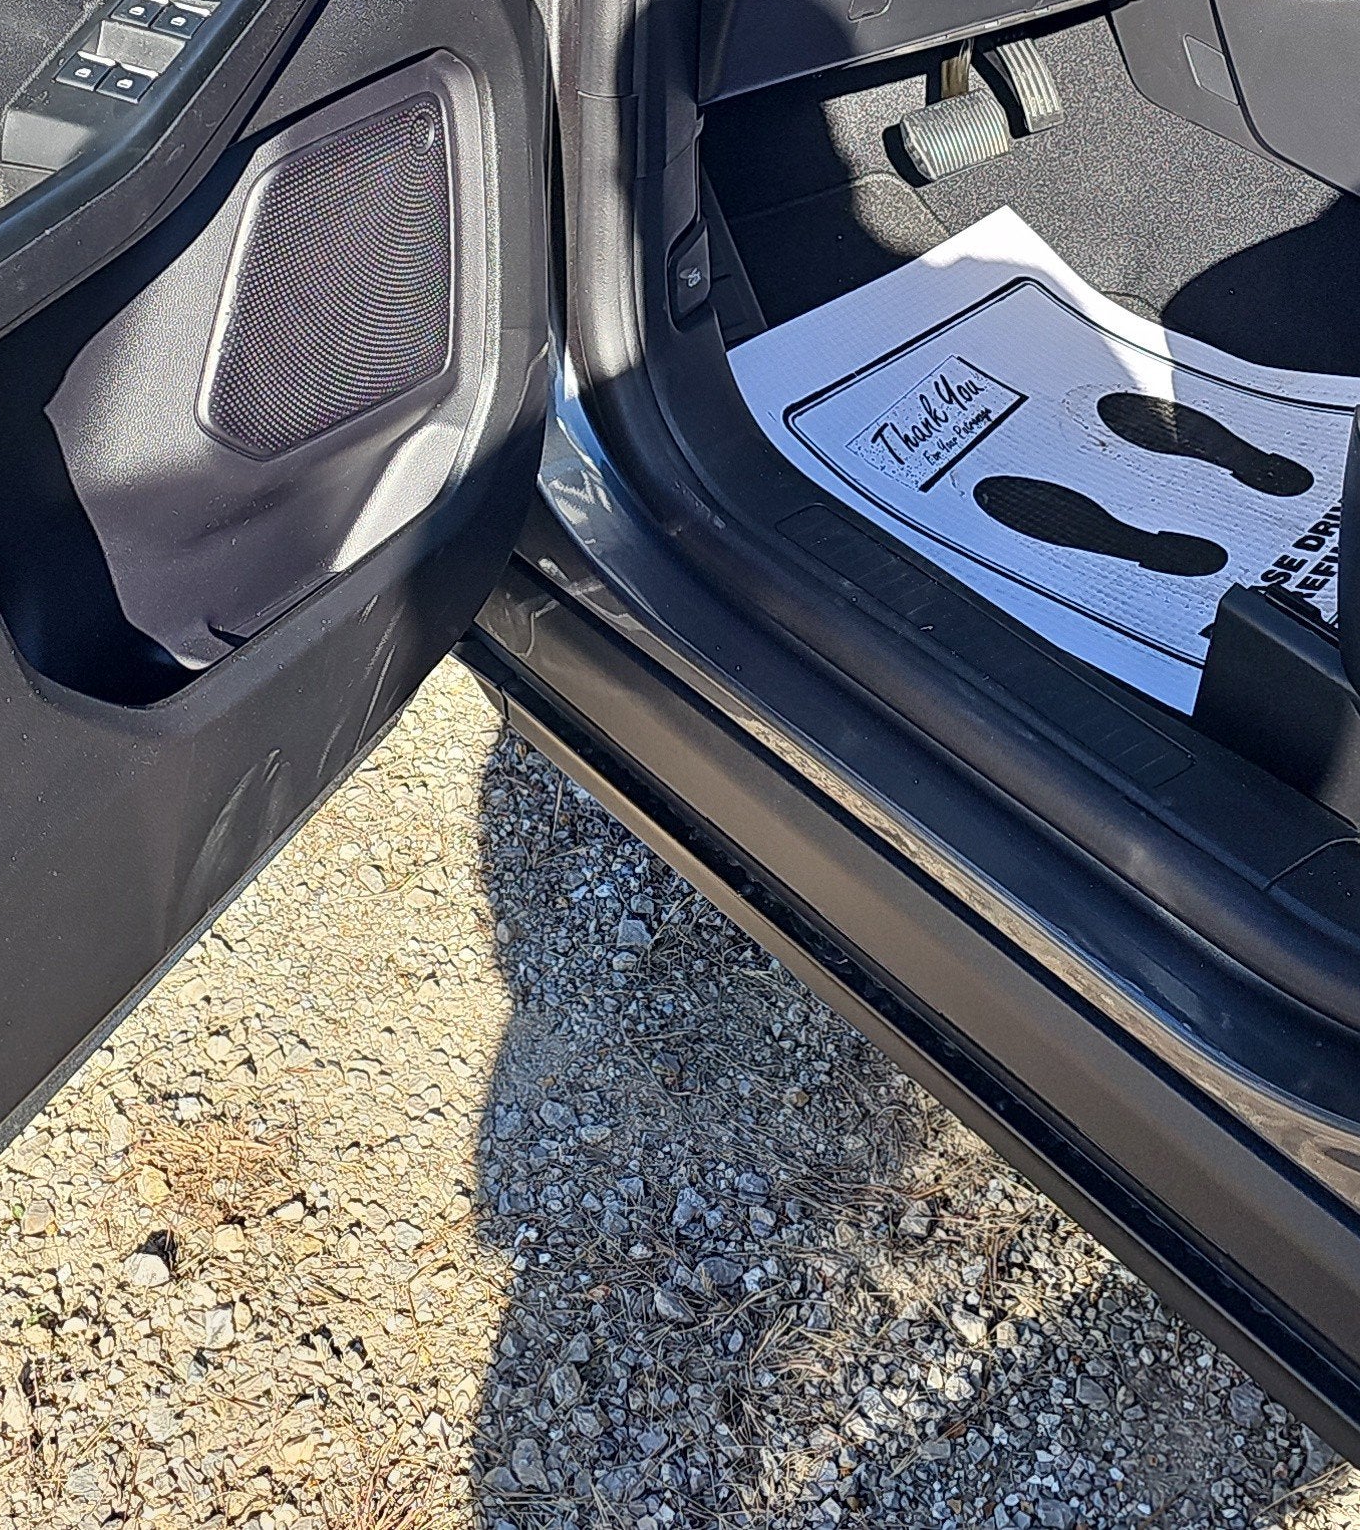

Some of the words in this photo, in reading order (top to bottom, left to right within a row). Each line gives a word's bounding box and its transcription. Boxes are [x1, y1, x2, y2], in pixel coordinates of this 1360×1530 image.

[871, 393, 949, 466] Thank
[933, 373, 986, 412] You
[937, 436, 958, 454] Your
[1256, 554, 1309, 589] SE
